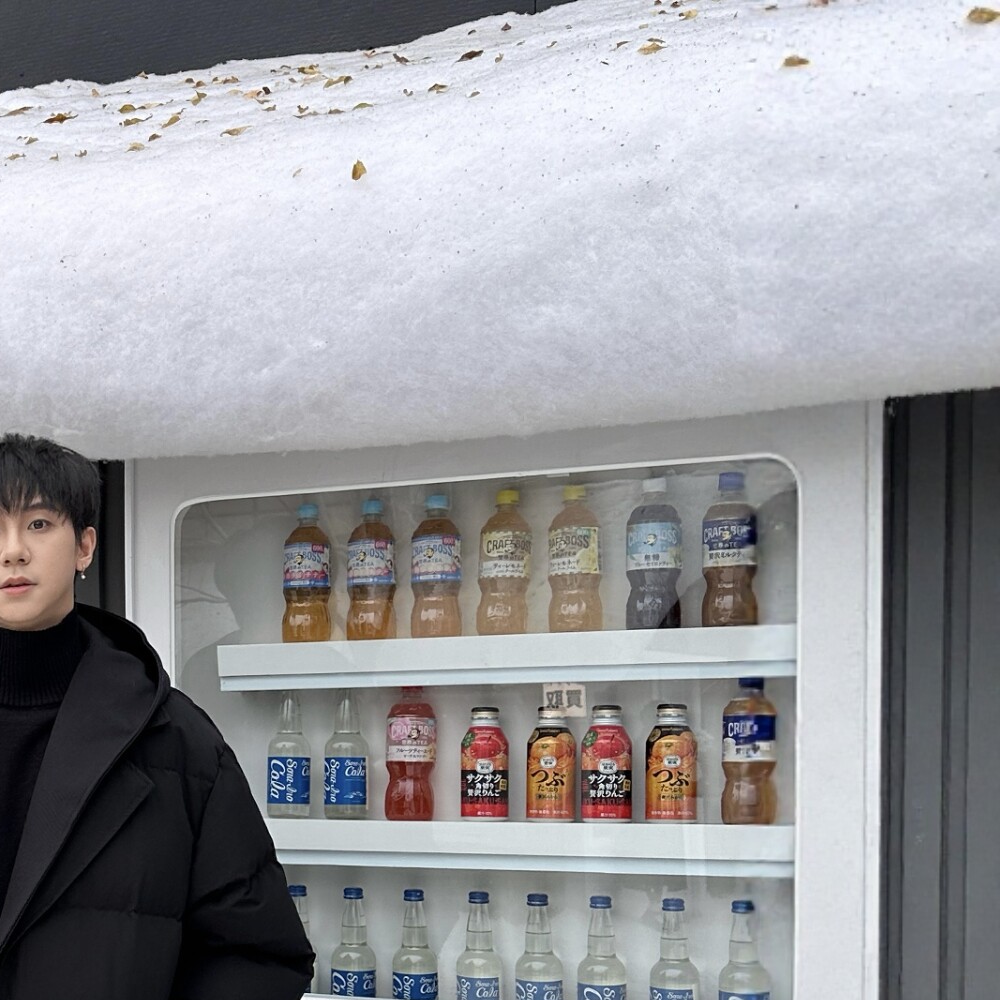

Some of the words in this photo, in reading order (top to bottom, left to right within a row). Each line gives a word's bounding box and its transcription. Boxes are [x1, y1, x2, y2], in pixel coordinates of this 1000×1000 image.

[270, 759, 286, 799] Cola
[466, 773, 502, 783] サクサク
[531, 769, 566, 787] つぶ
[588, 774, 626, 785] サクサク
[652, 769, 690, 787] つぶ
